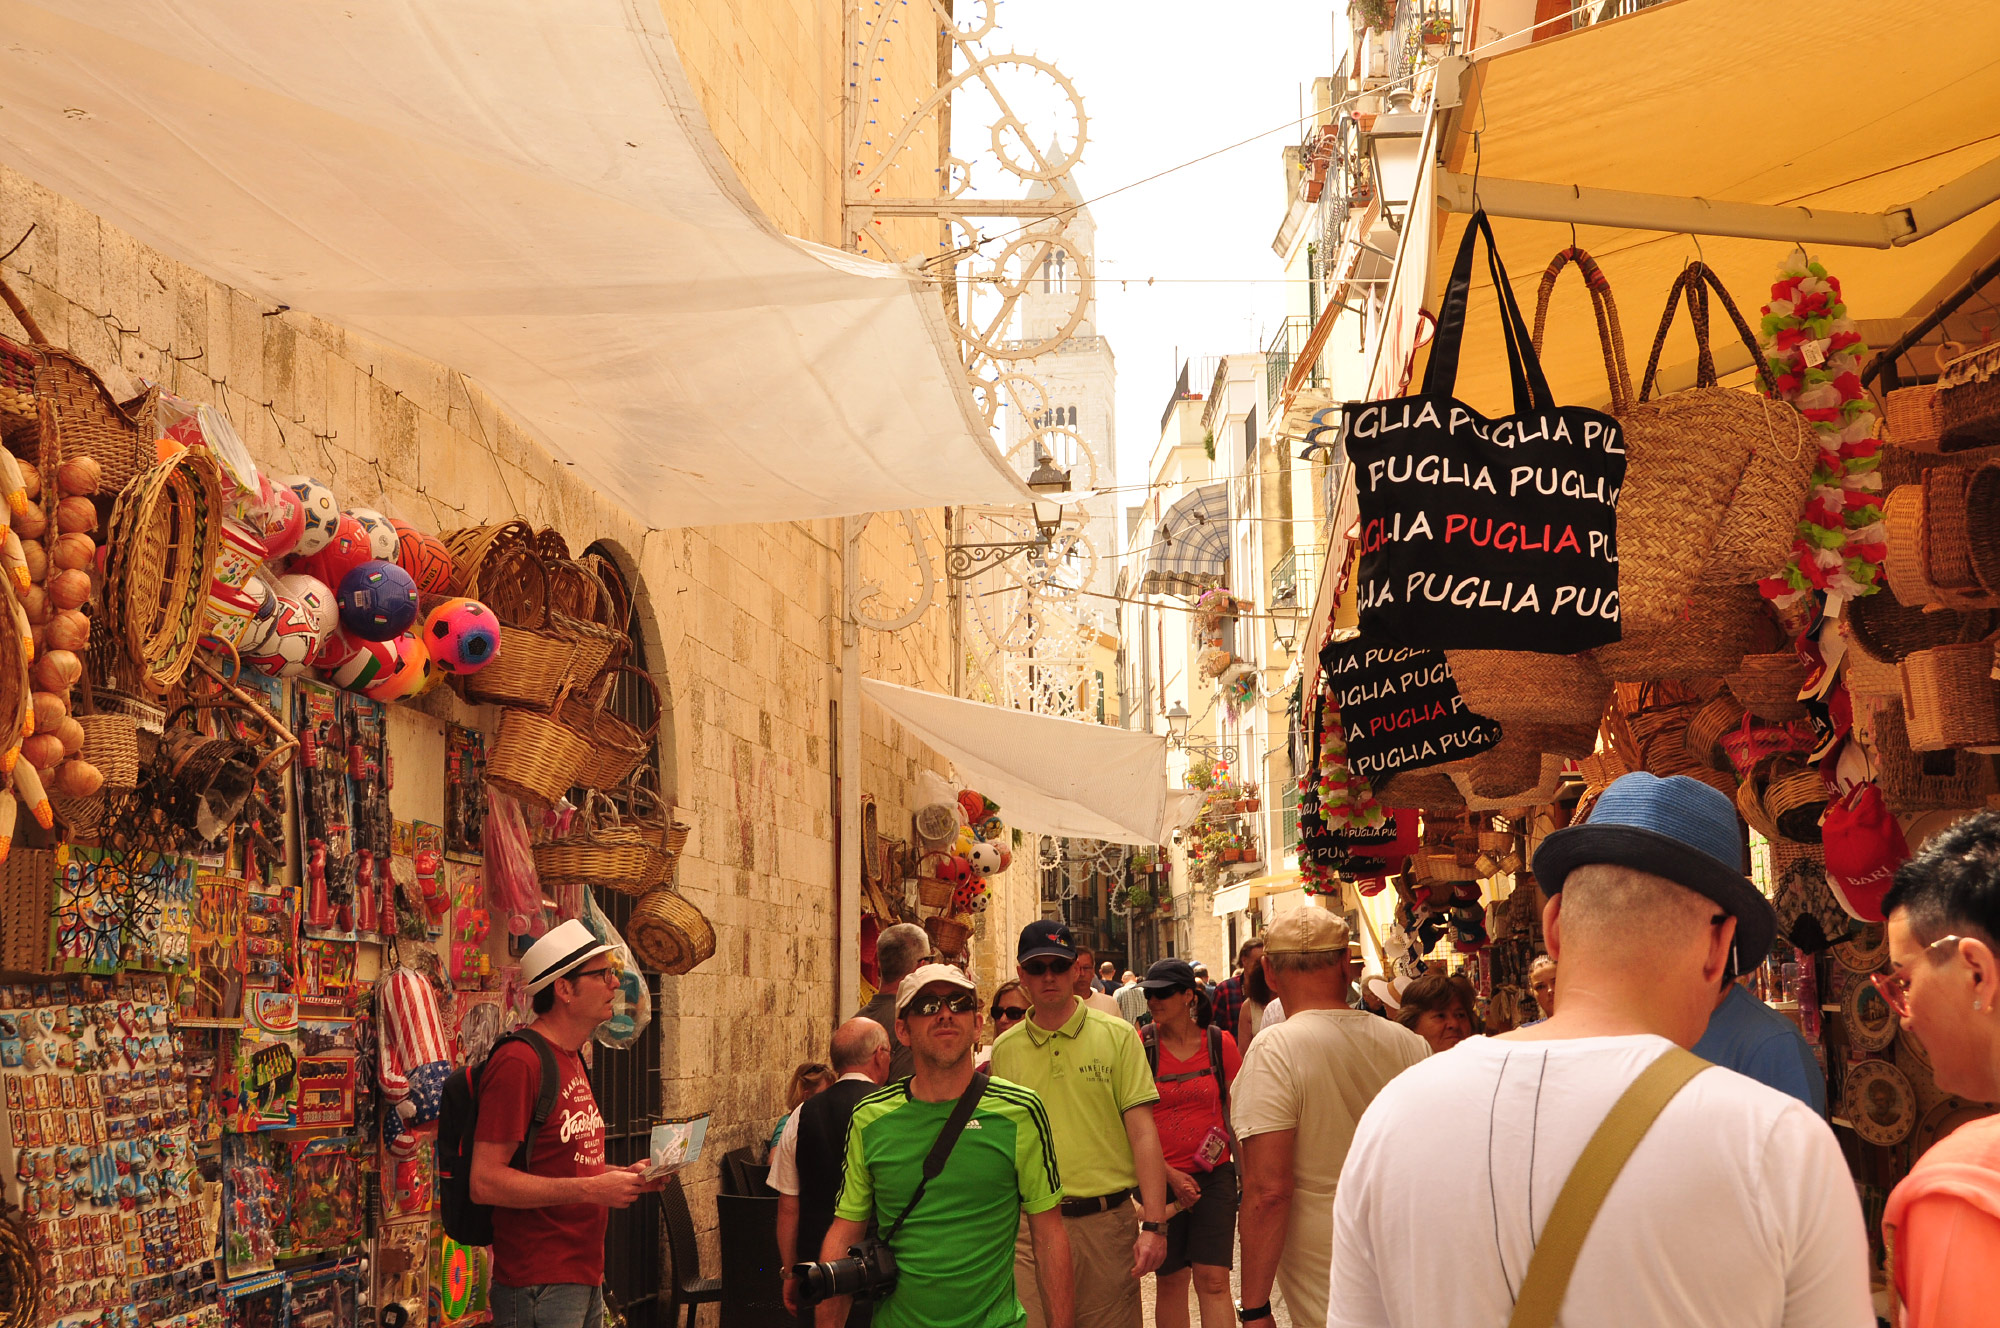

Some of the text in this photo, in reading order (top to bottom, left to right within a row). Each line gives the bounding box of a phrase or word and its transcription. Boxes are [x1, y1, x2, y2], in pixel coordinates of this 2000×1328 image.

[1450, 407, 1573, 449] PUGLIA
[1445, 514, 1581, 553] PUGLIA
[1406, 572, 1540, 613] PUGLIA
[1551, 585, 1619, 622] PUG
[1369, 700, 1447, 737] PUGLIA
[1357, 740, 1437, 776] PUGLIA
[1349, 828, 1380, 838] PUGLIA
[1846, 865, 1892, 886] BARI
